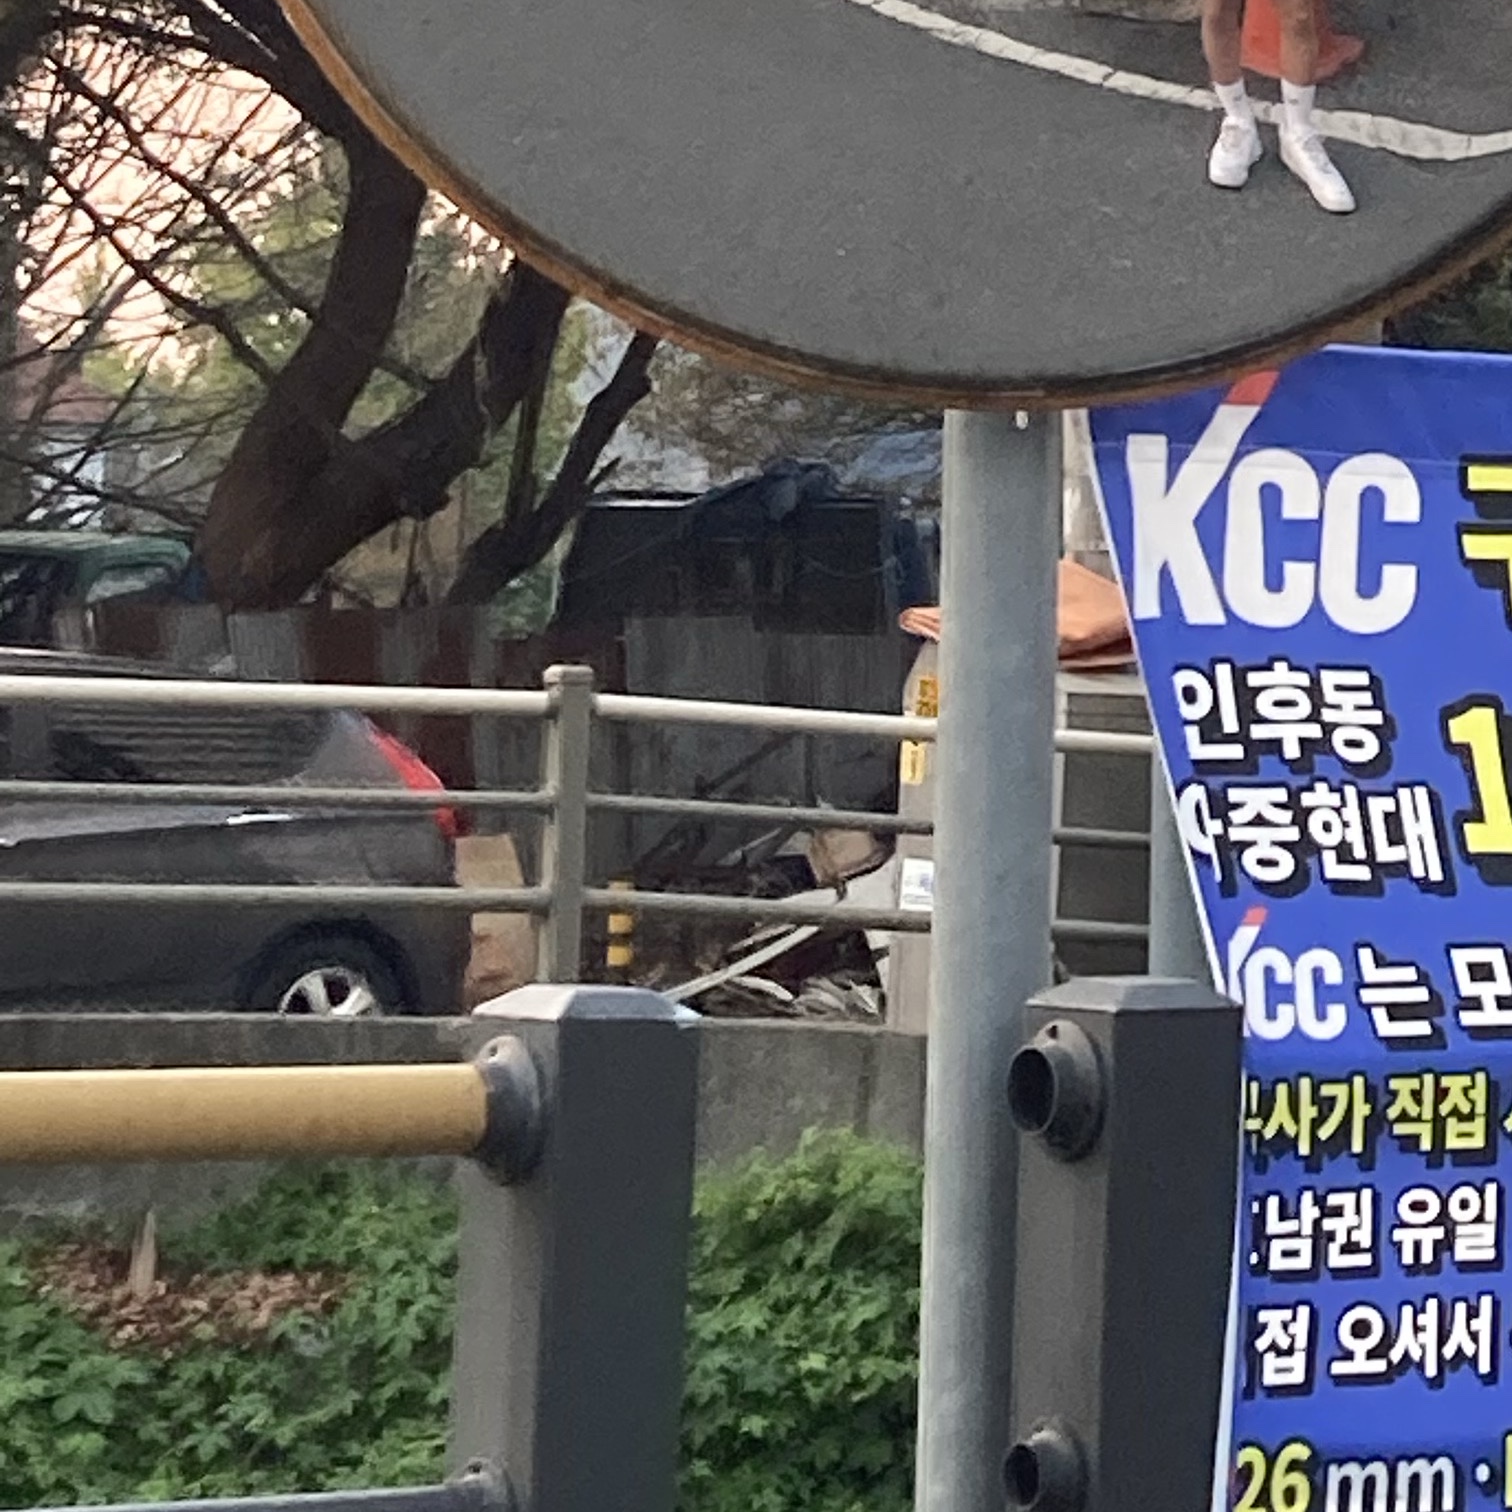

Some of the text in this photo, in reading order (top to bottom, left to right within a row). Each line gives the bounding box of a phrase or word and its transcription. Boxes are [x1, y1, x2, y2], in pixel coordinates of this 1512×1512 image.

[1126, 371, 1421, 634] KCC
[1172, 661, 1383, 763] 인후동
[1386, 1072, 1487, 1152] 직접
[1250, 1188, 1373, 1272] 남권
[1393, 1182, 1498, 1265] 유일
[1243, 1305, 1310, 1386] 접
[1330, 1293, 1493, 1378] 오셔서
